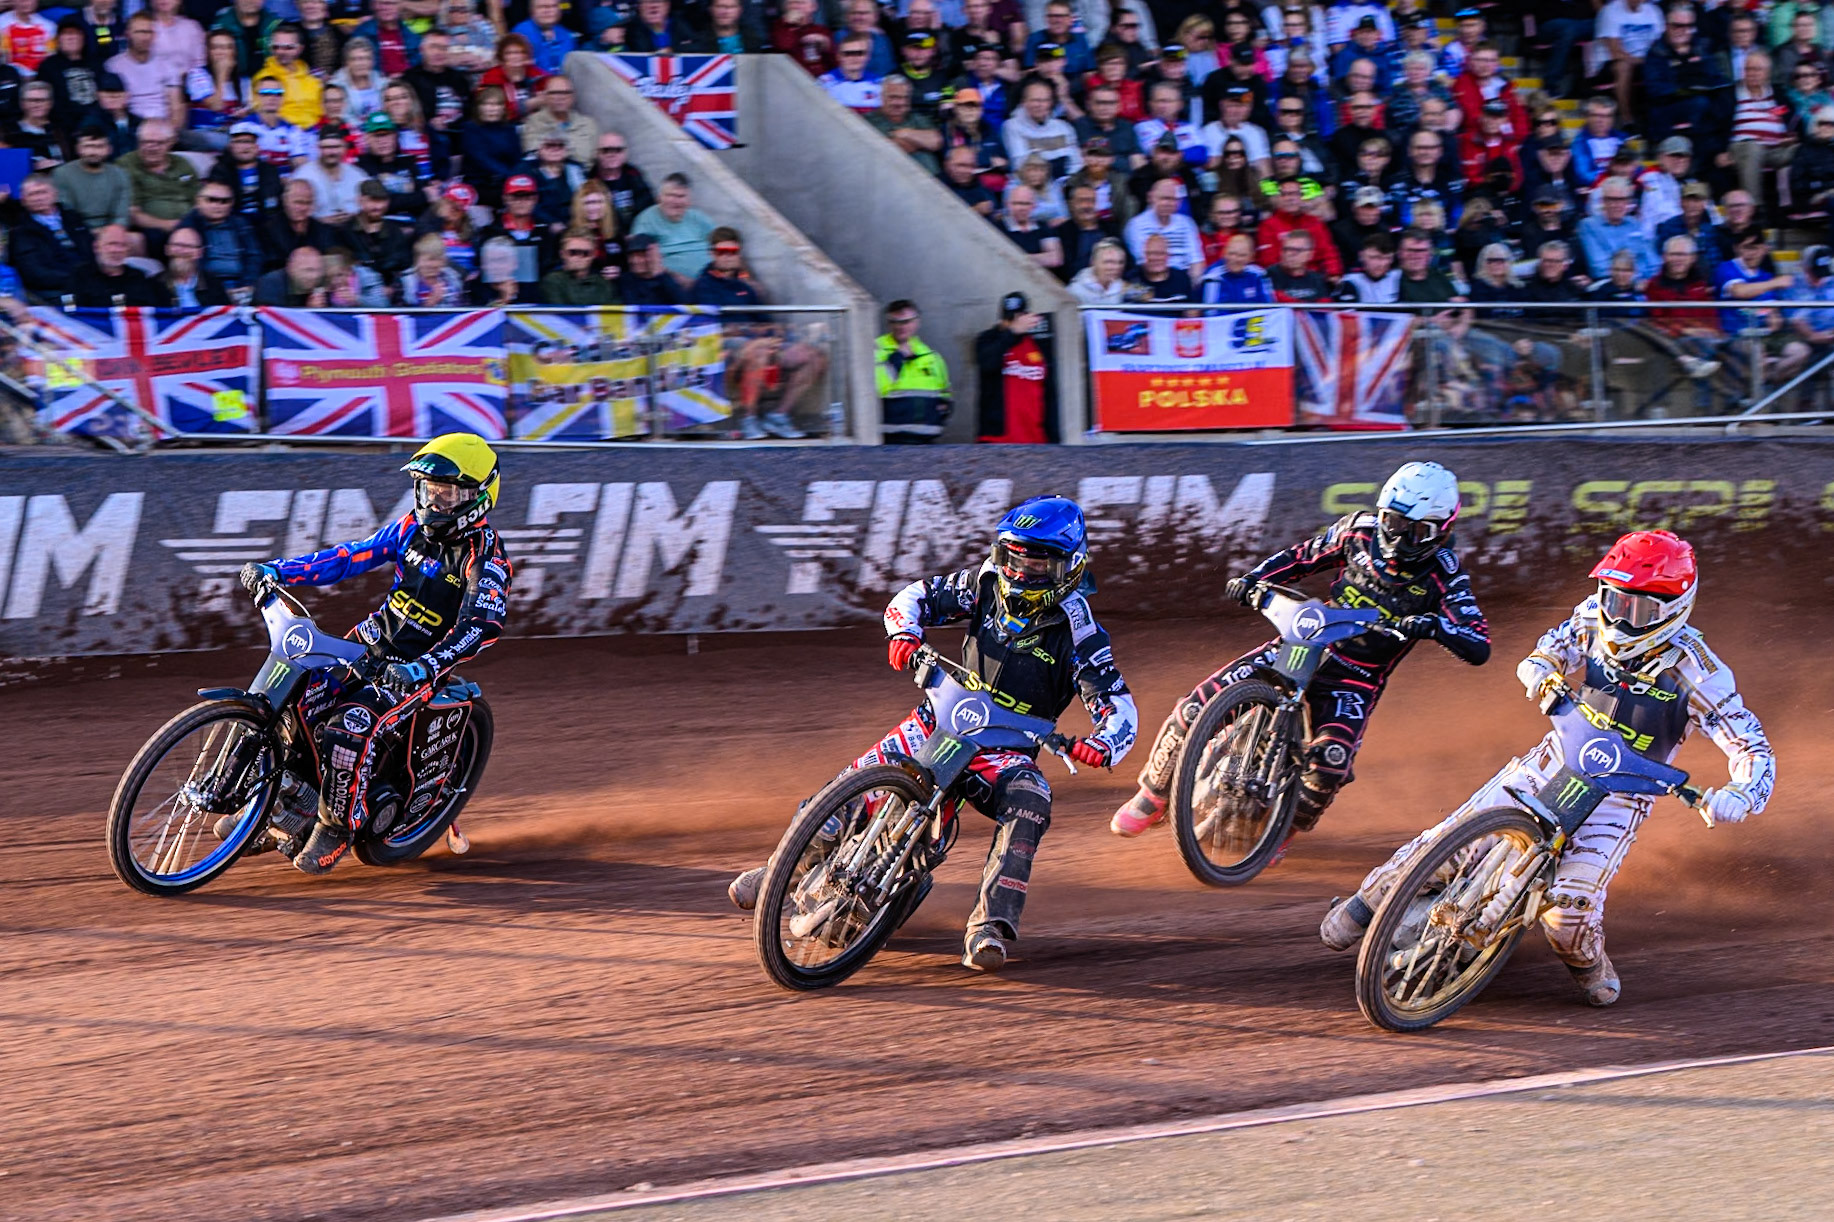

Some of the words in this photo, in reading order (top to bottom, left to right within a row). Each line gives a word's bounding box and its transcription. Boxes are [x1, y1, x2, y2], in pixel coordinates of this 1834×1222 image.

[1138, 387, 1249, 409] POLSKA
[497, 480, 742, 602] FIM
[286, 632, 308, 651] ATPI
[956, 706, 984, 727] ATPI
[1584, 746, 1614, 769] ATPI
[333, 770, 352, 819] Choices
